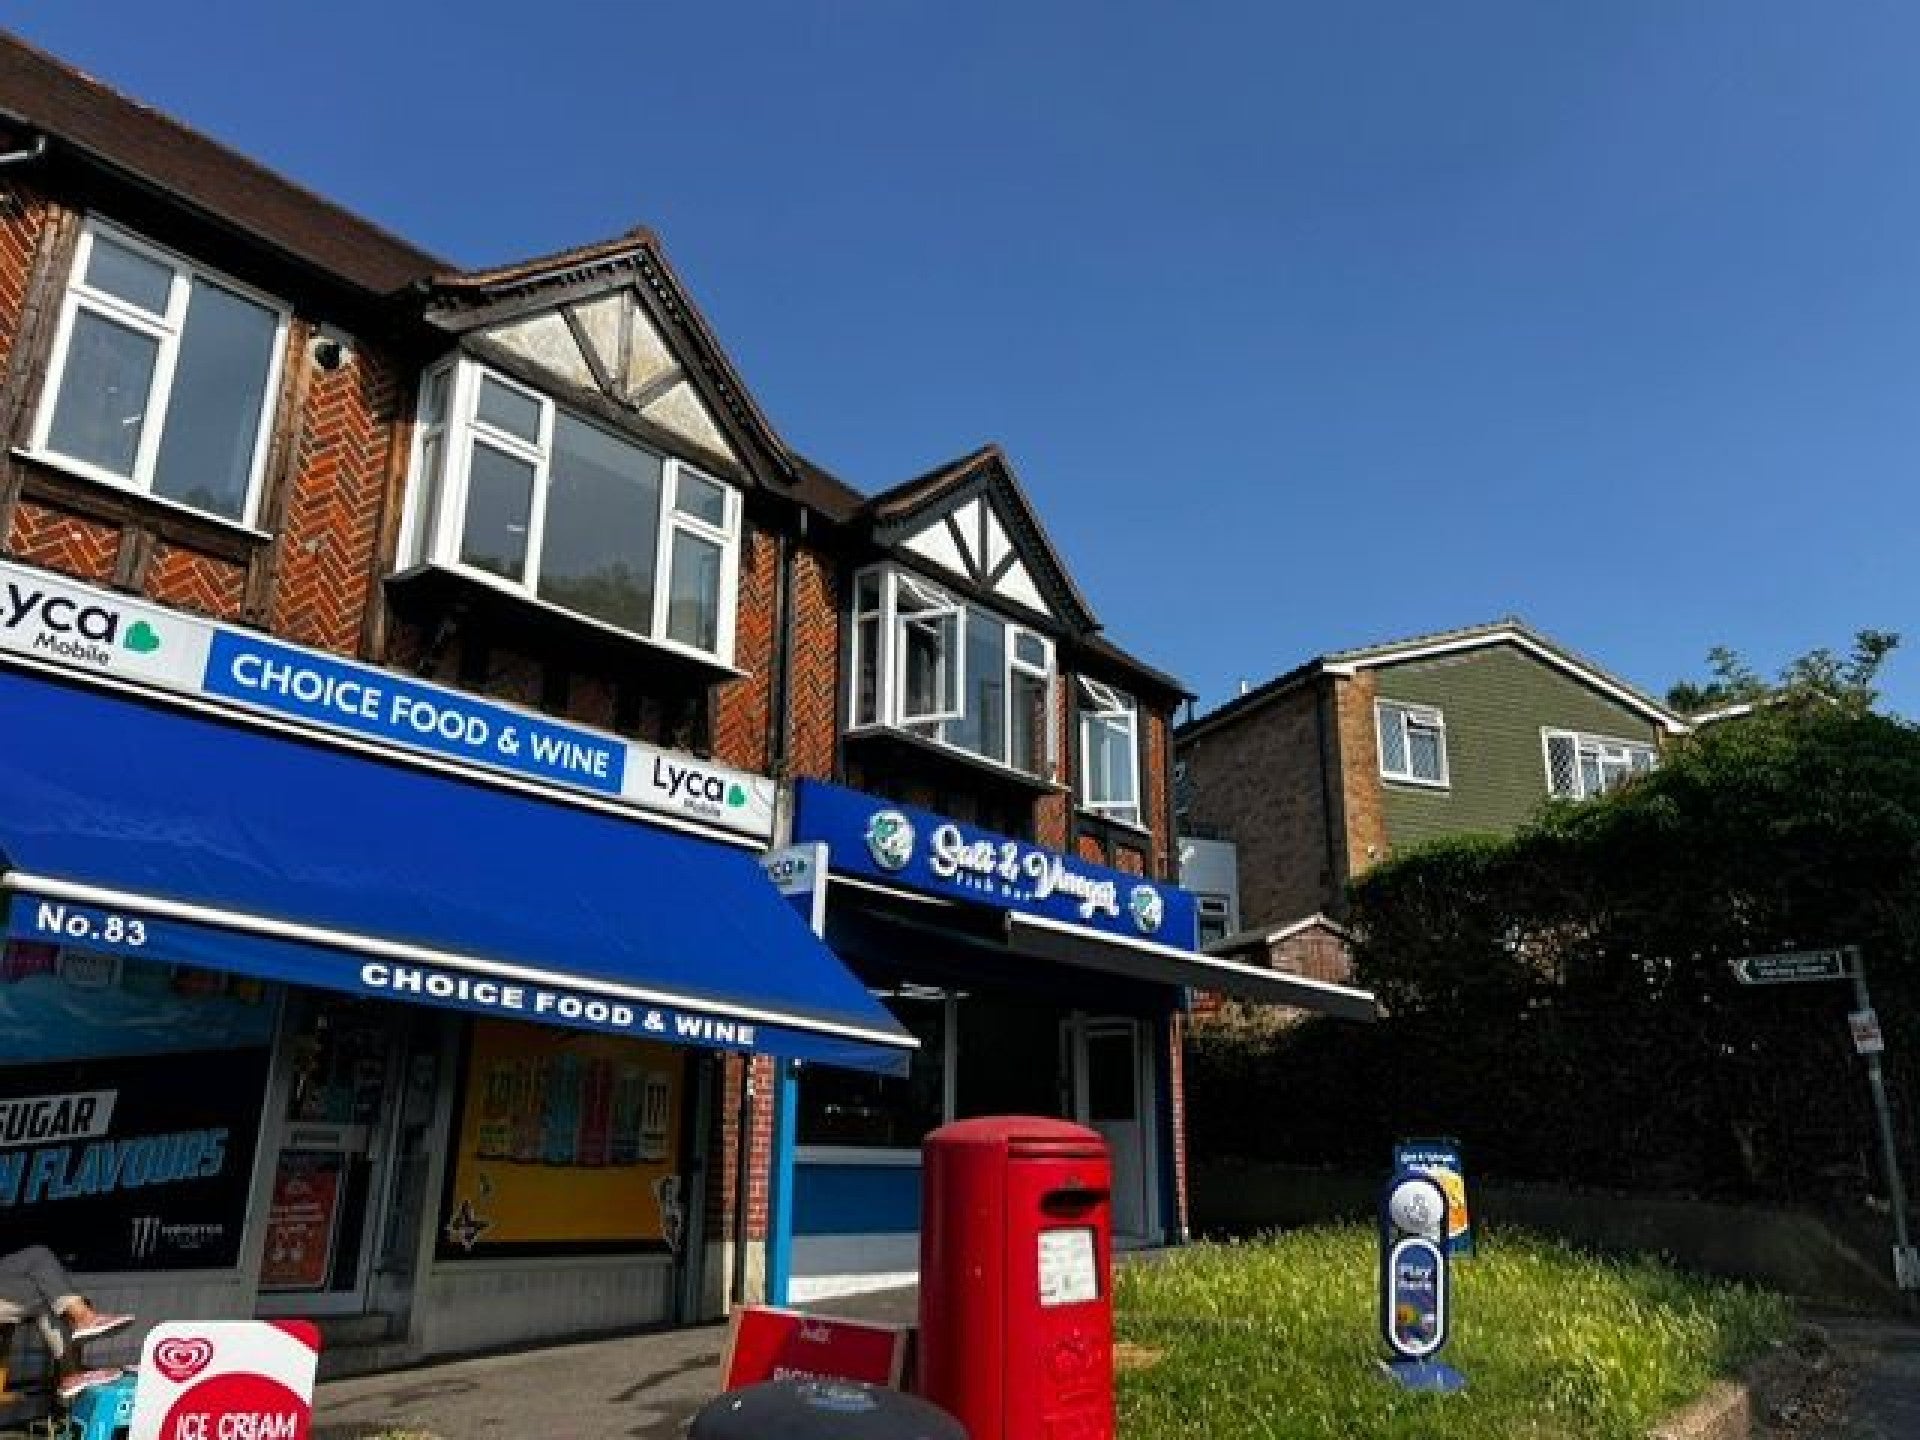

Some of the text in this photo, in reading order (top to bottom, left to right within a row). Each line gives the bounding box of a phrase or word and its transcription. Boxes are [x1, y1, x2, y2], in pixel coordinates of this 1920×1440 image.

[0, 583, 119, 644] yca
[33, 632, 110, 666] Mobile
[231, 653, 610, 778] CHOICE FOOD & WINE
[652, 754, 724, 804] Lyca
[37, 902, 147, 946] No.83
[360, 961, 756, 1046] CHOICE FOOD & WINE
[24, 1127, 229, 1204] FLAVOURS
[177, 1412, 298, 1440] ICE CREAM
